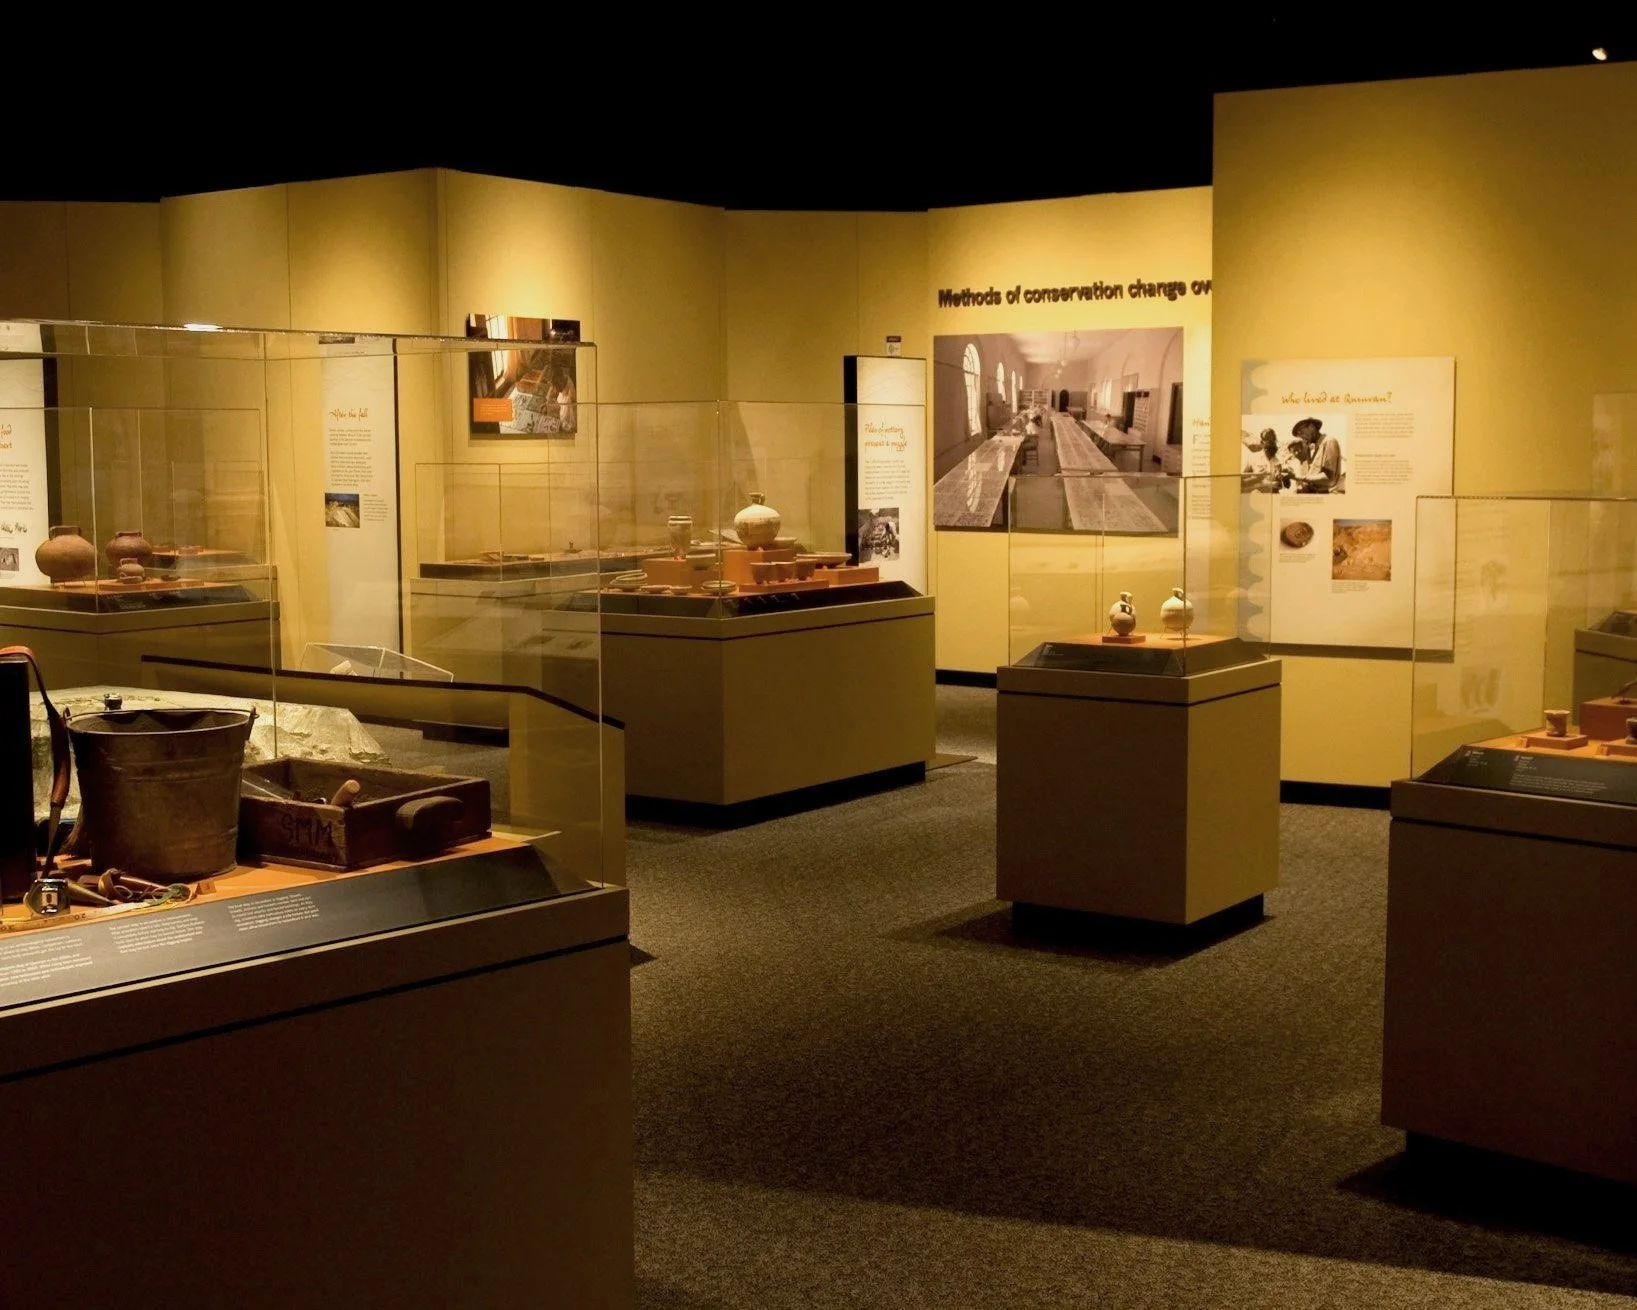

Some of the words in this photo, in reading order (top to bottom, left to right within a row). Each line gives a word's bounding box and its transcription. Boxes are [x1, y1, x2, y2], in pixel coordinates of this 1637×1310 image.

[938, 287, 1001, 308] Methods
[1005, 285, 1021, 304] of
[1023, 281, 1123, 304] conservation
[1127, 279, 1187, 301] change
[1191, 279, 1213, 296] ov
[328, 408, 347, 421] After
[348, 408, 357, 418] the
